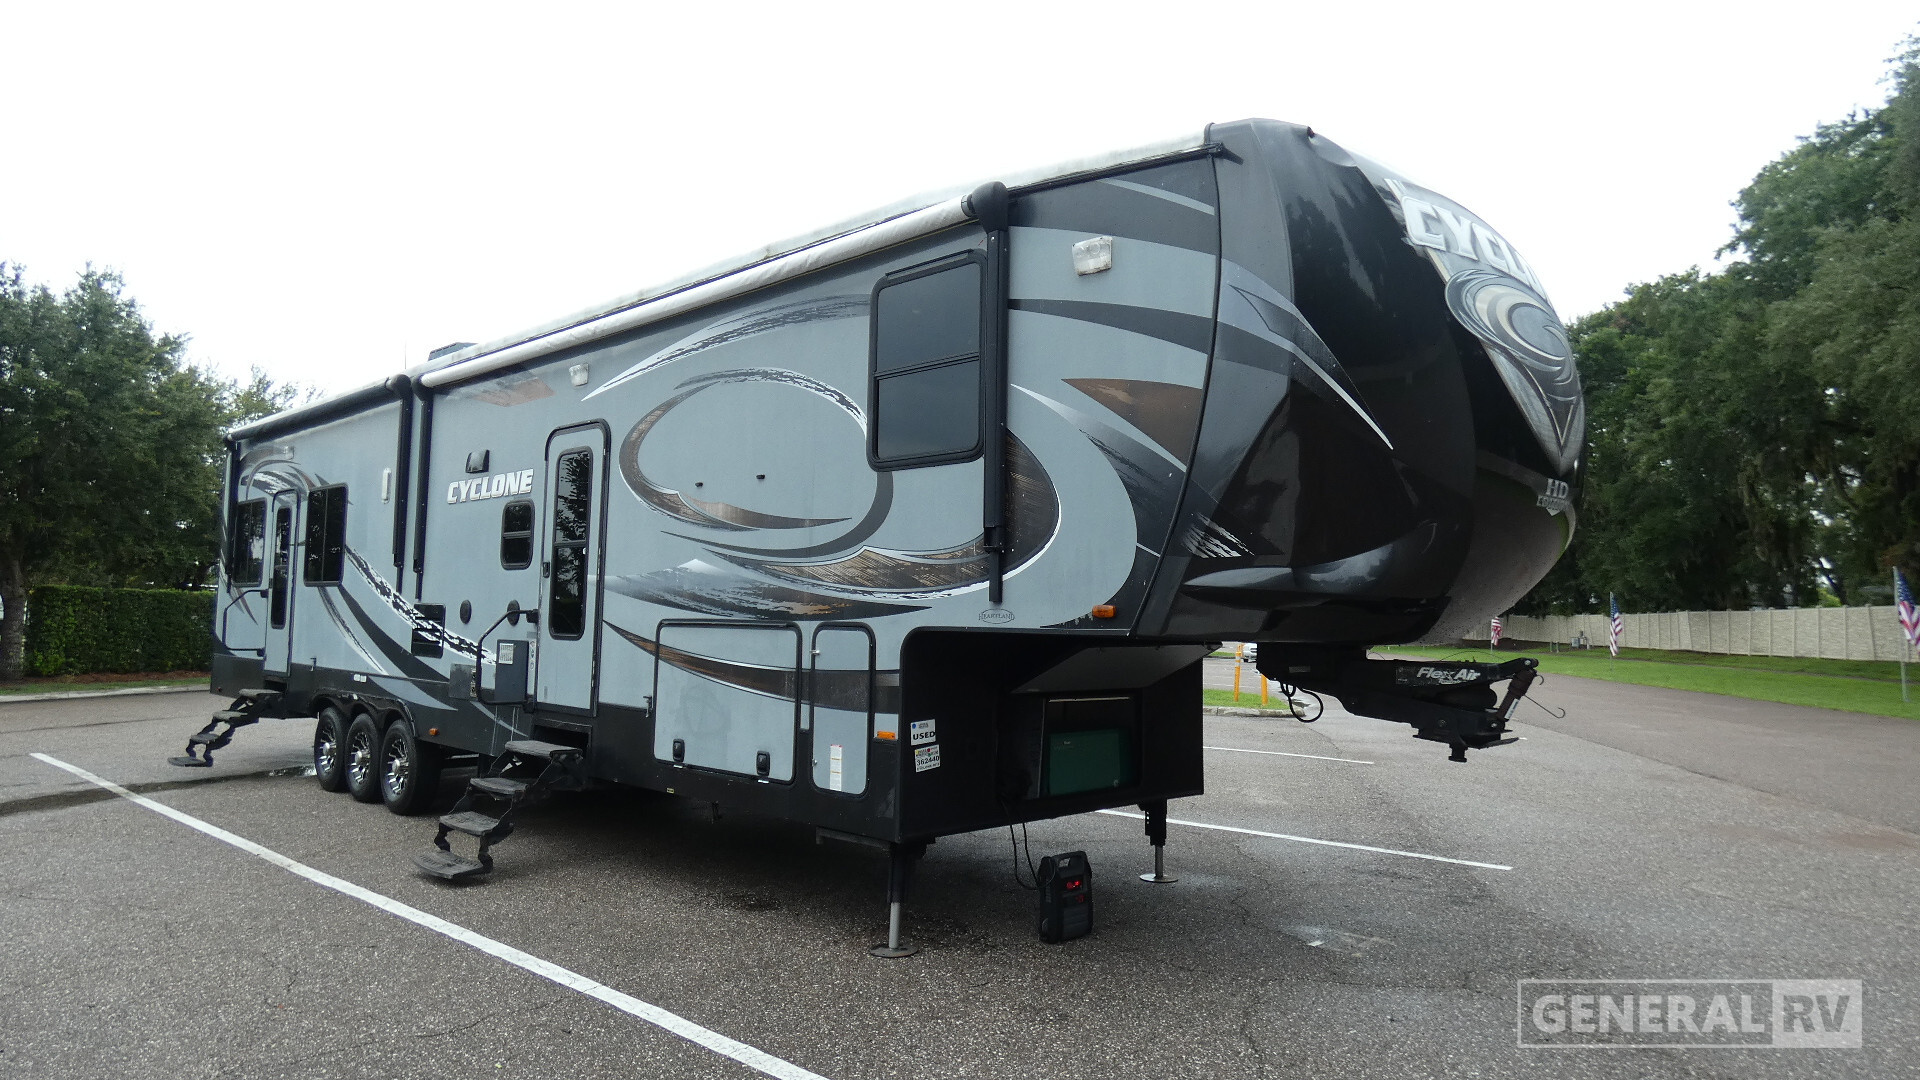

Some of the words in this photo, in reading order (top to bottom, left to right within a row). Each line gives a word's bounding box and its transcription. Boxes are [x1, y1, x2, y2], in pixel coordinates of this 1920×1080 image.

[446, 468, 534, 505] CYCLONE
[1545, 478, 1569, 499] HD
[978, 613, 1015, 621] HEARTLAND
[912, 731, 936, 741] USED
[916, 756, 940, 766] 362440
